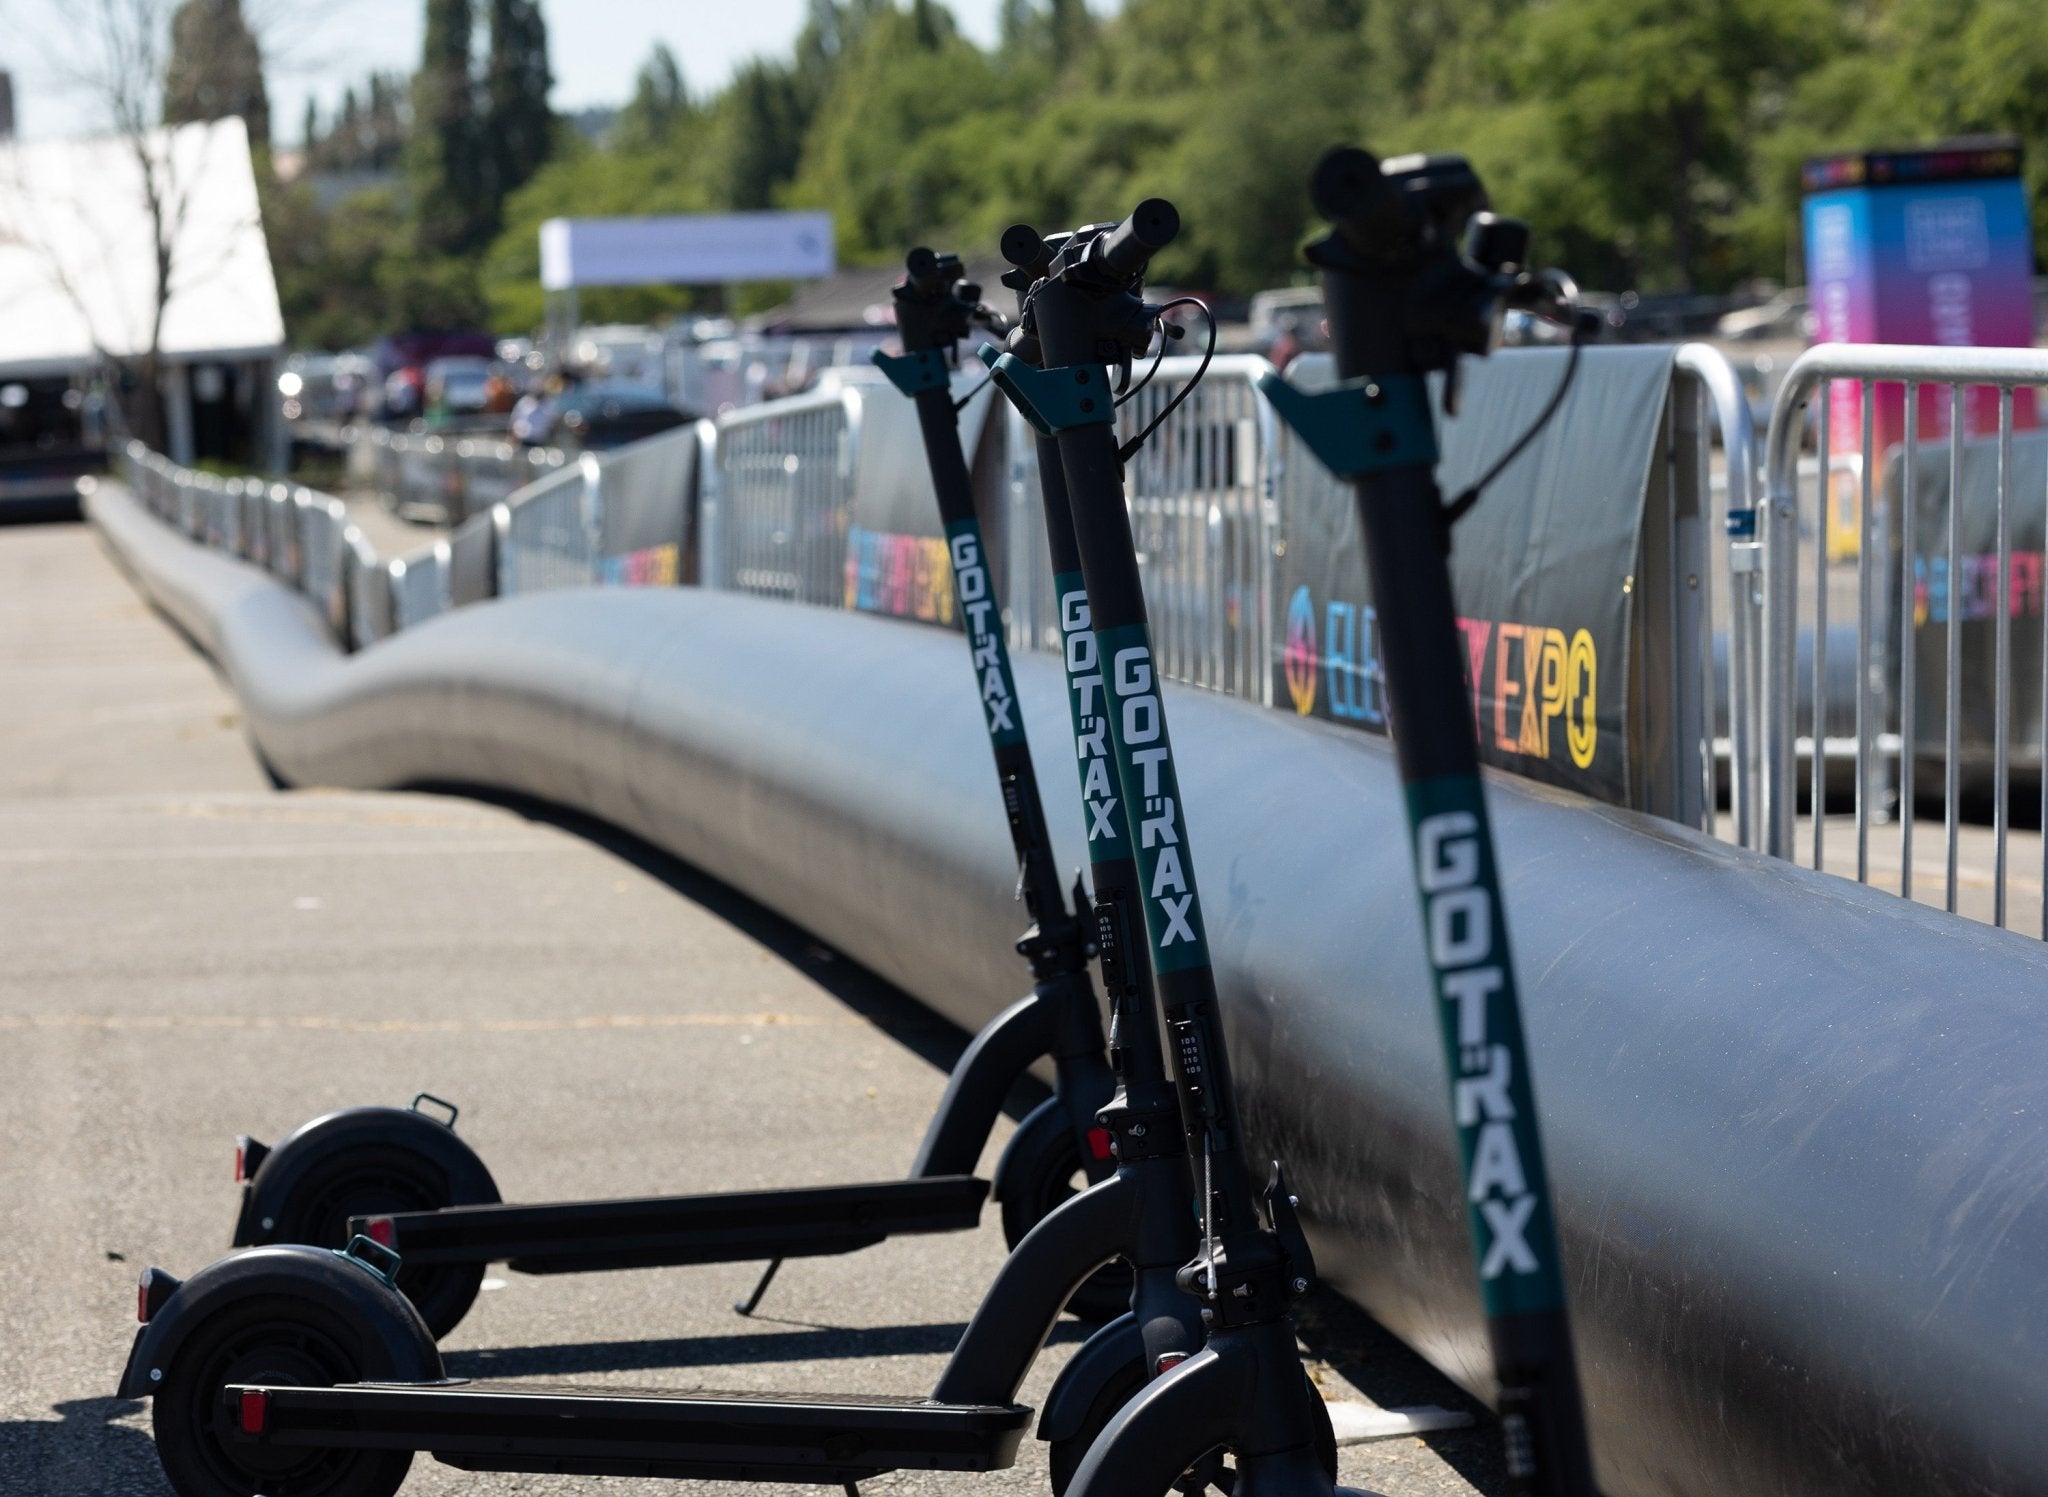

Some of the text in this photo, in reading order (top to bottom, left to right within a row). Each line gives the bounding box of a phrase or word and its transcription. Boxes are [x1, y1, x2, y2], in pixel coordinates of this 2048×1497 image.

[951, 533, 1014, 733] GOTRAX
[1061, 590, 1117, 841] GOTRAX
[1494, 621, 1598, 770] EXPO
[1114, 646, 1197, 947] GOTRAX
[1417, 811, 1539, 1278] GOTRAX
